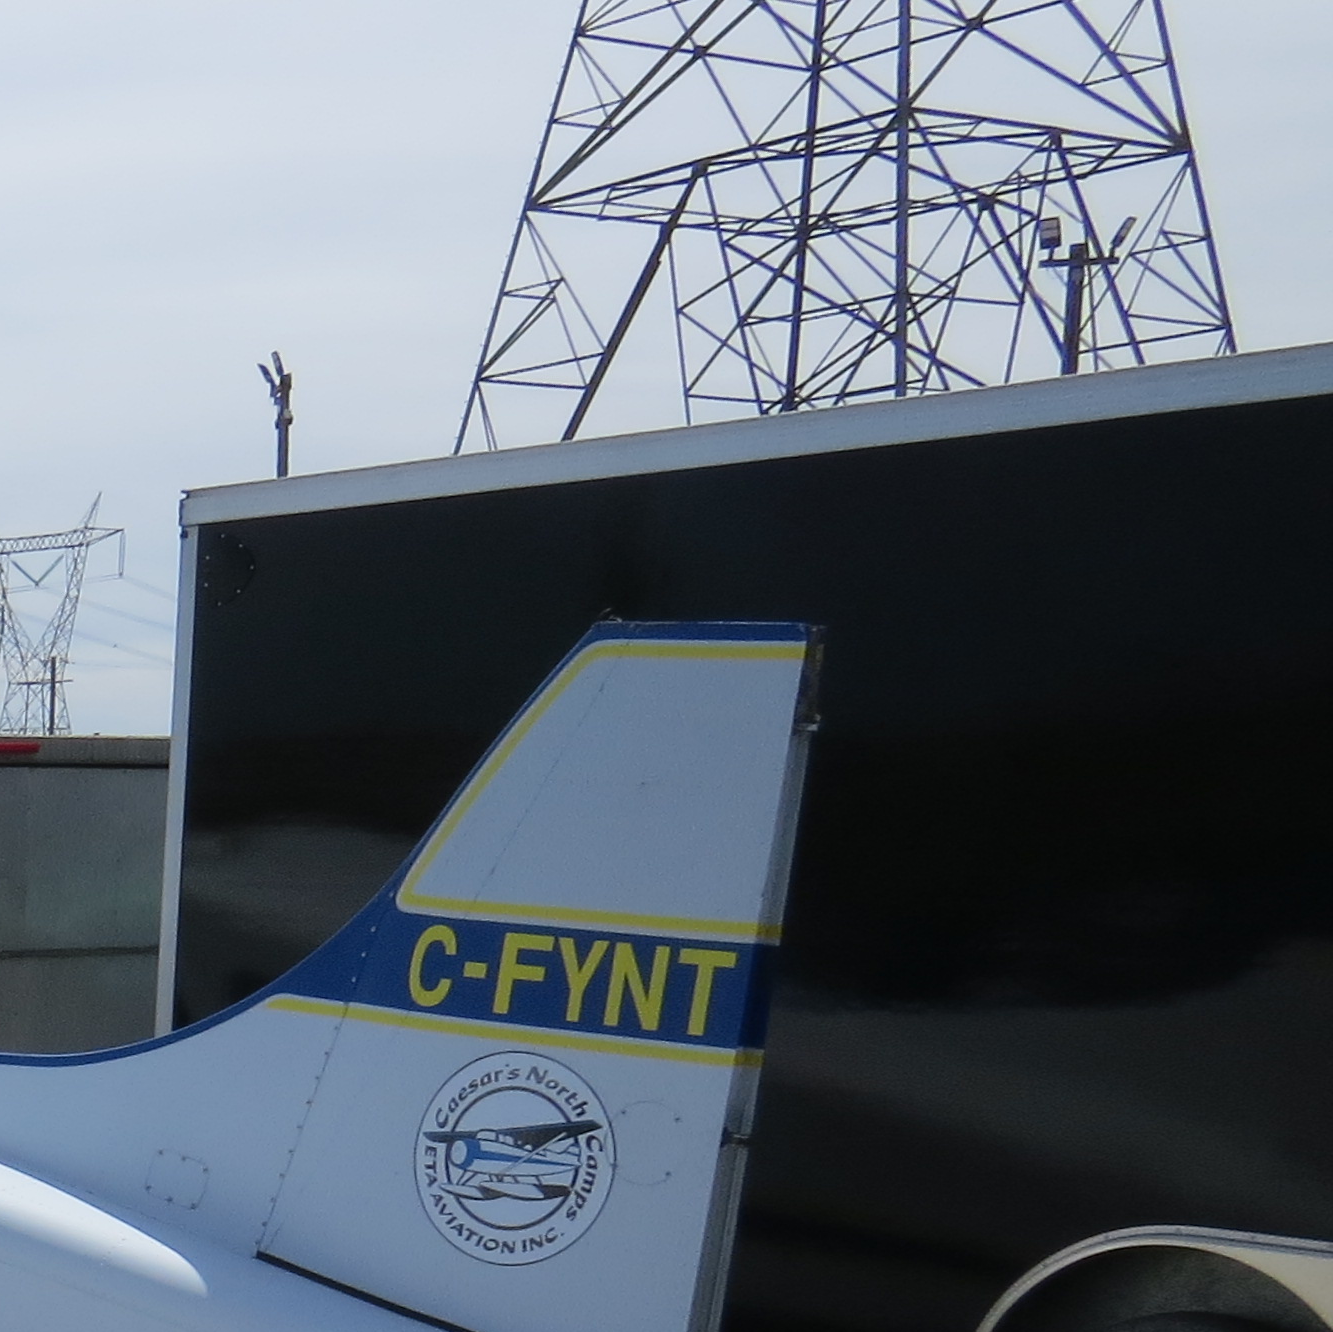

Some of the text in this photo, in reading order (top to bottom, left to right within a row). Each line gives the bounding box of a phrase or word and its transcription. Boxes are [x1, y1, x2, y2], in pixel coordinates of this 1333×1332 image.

[408, 924, 739, 1037] C-FYNT
[434, 1063, 603, 1222] Caesar's North Camps
[424, 1146, 566, 1255] ETA AVIATION INC.
